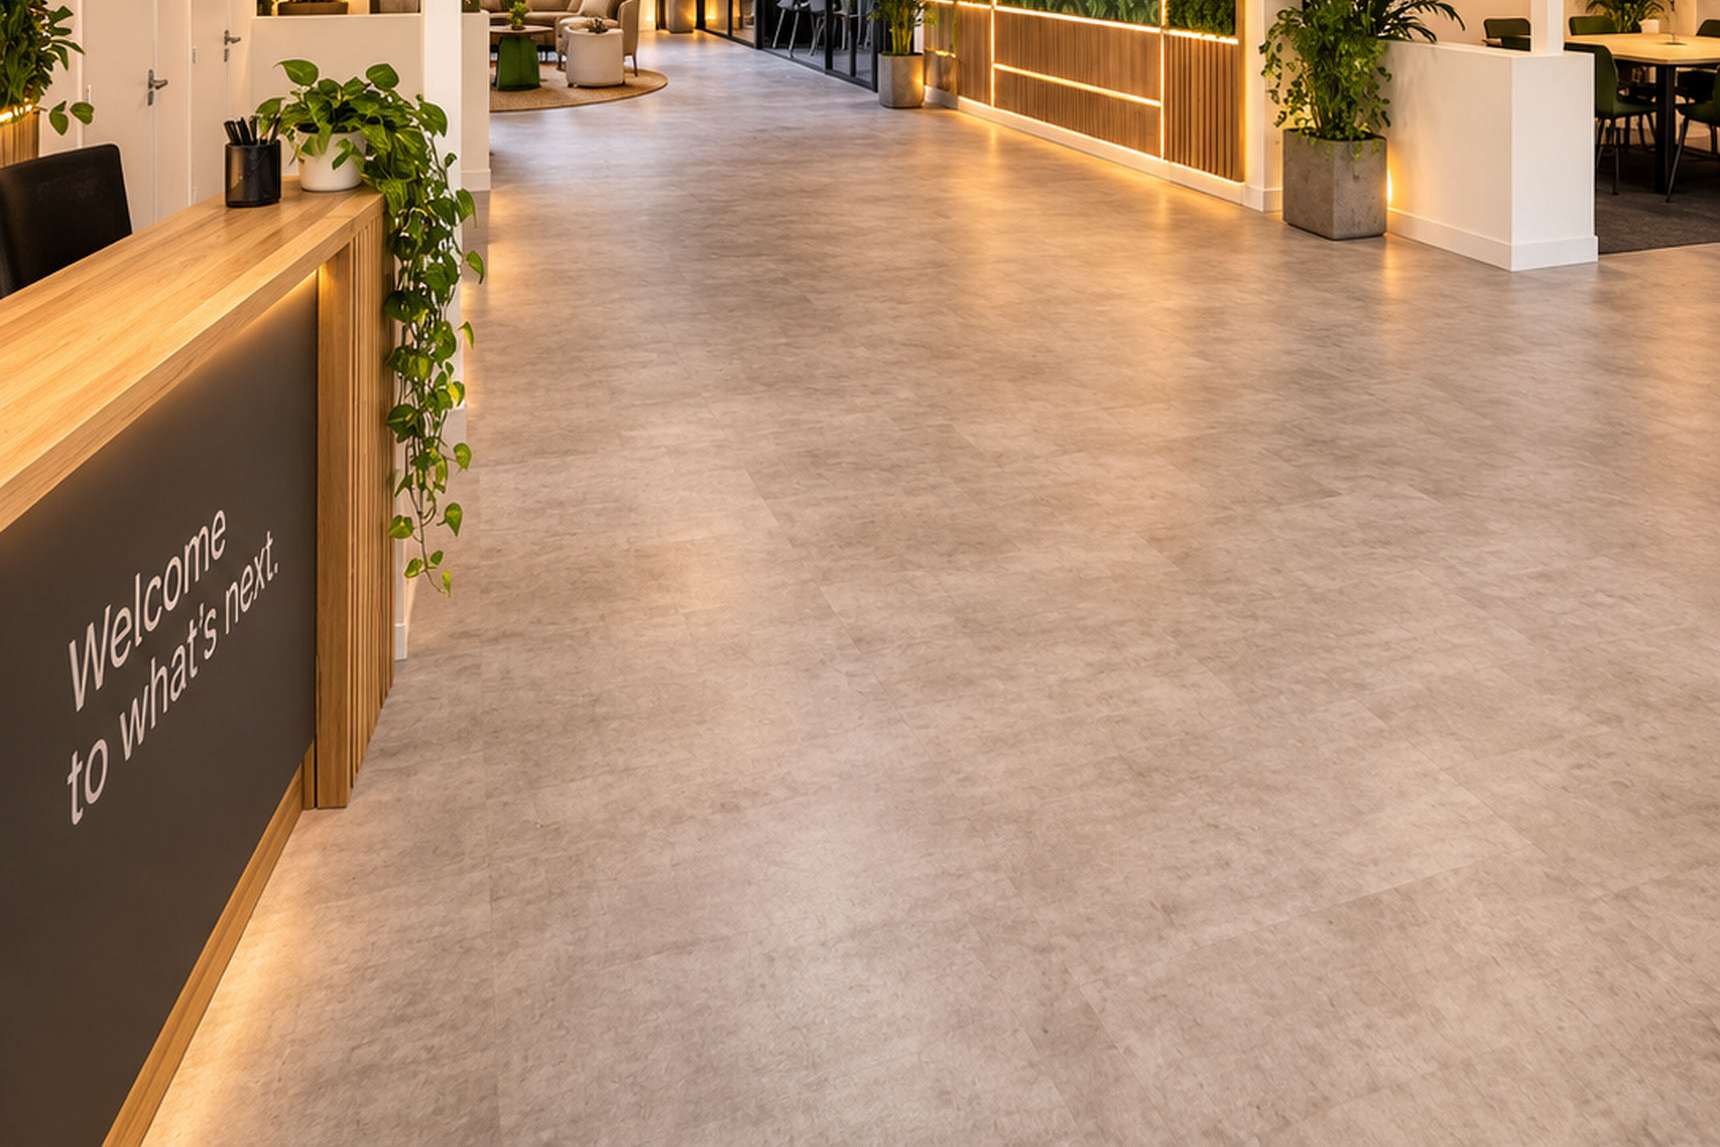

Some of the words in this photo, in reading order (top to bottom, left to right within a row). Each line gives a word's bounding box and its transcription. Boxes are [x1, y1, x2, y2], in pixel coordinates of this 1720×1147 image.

[67, 738, 109, 825] to
[119, 602, 217, 761] what's
[225, 530, 279, 635] next.
[69, 510, 227, 712] Welcome
